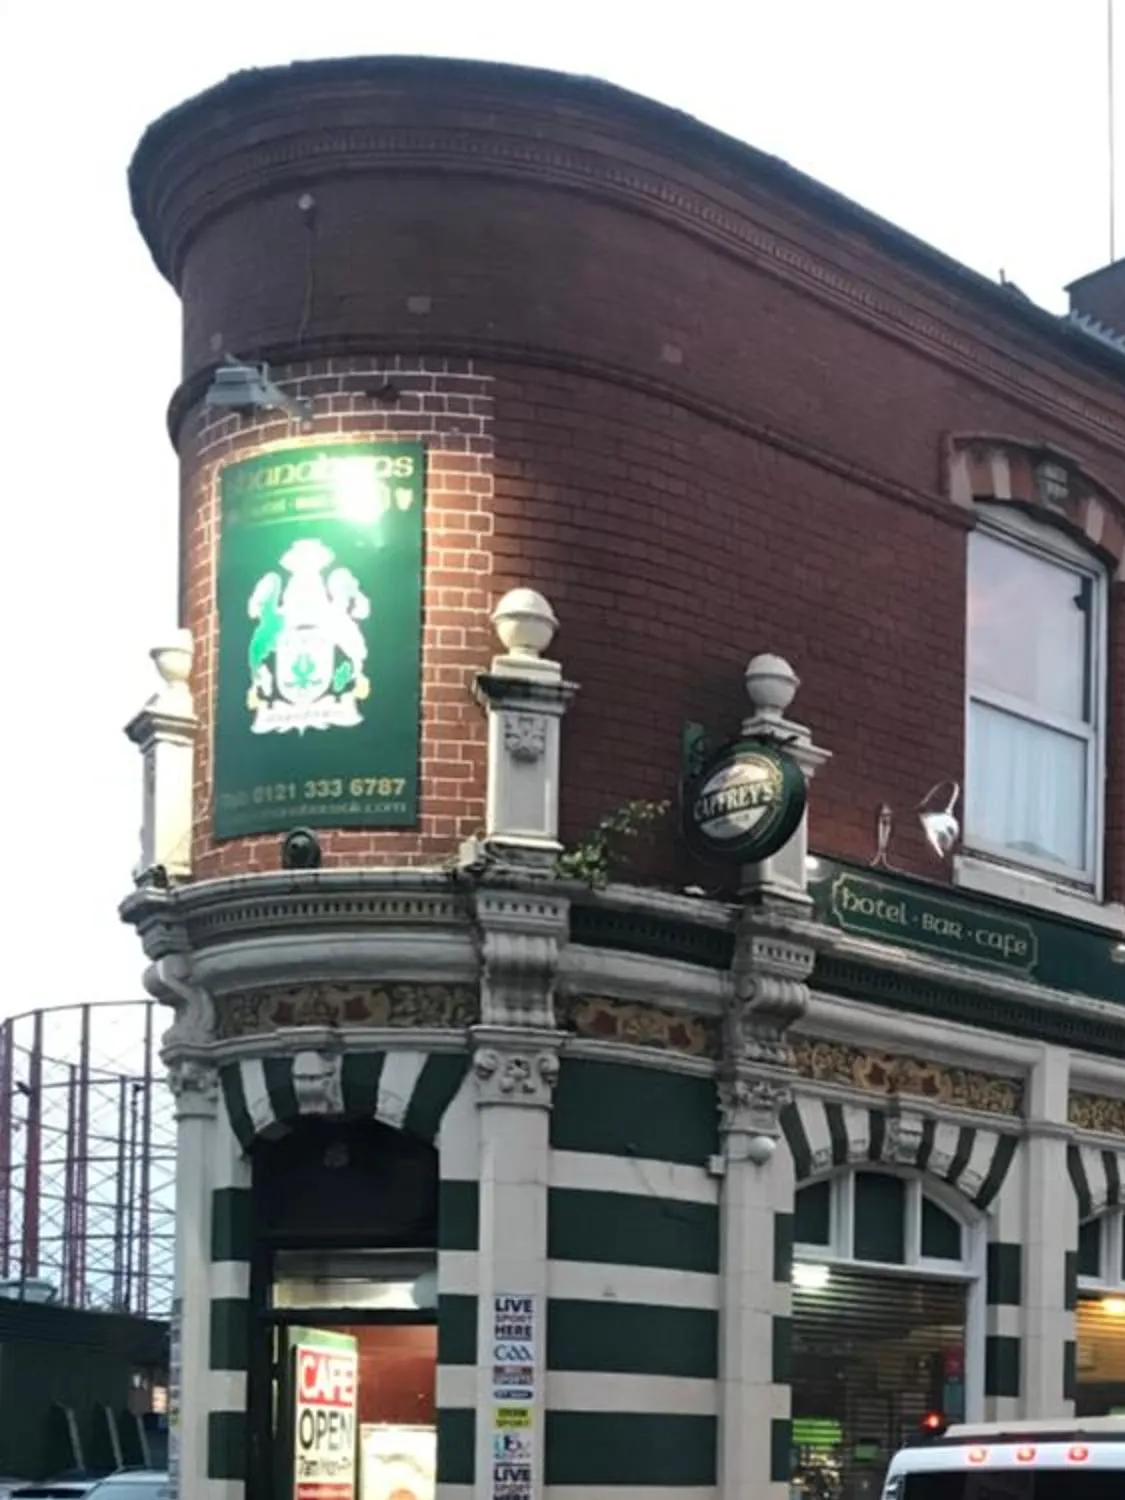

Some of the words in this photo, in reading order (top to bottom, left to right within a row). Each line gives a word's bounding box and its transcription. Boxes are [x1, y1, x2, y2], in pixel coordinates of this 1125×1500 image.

[304, 779, 342, 798] 333
[350, 777, 406, 797] 6787
[495, 1298, 532, 1312] LIVE
[495, 1325, 532, 1338] HERE
[300, 1408, 353, 1451] OPEN
[494, 1469, 531, 1481] LIVE
